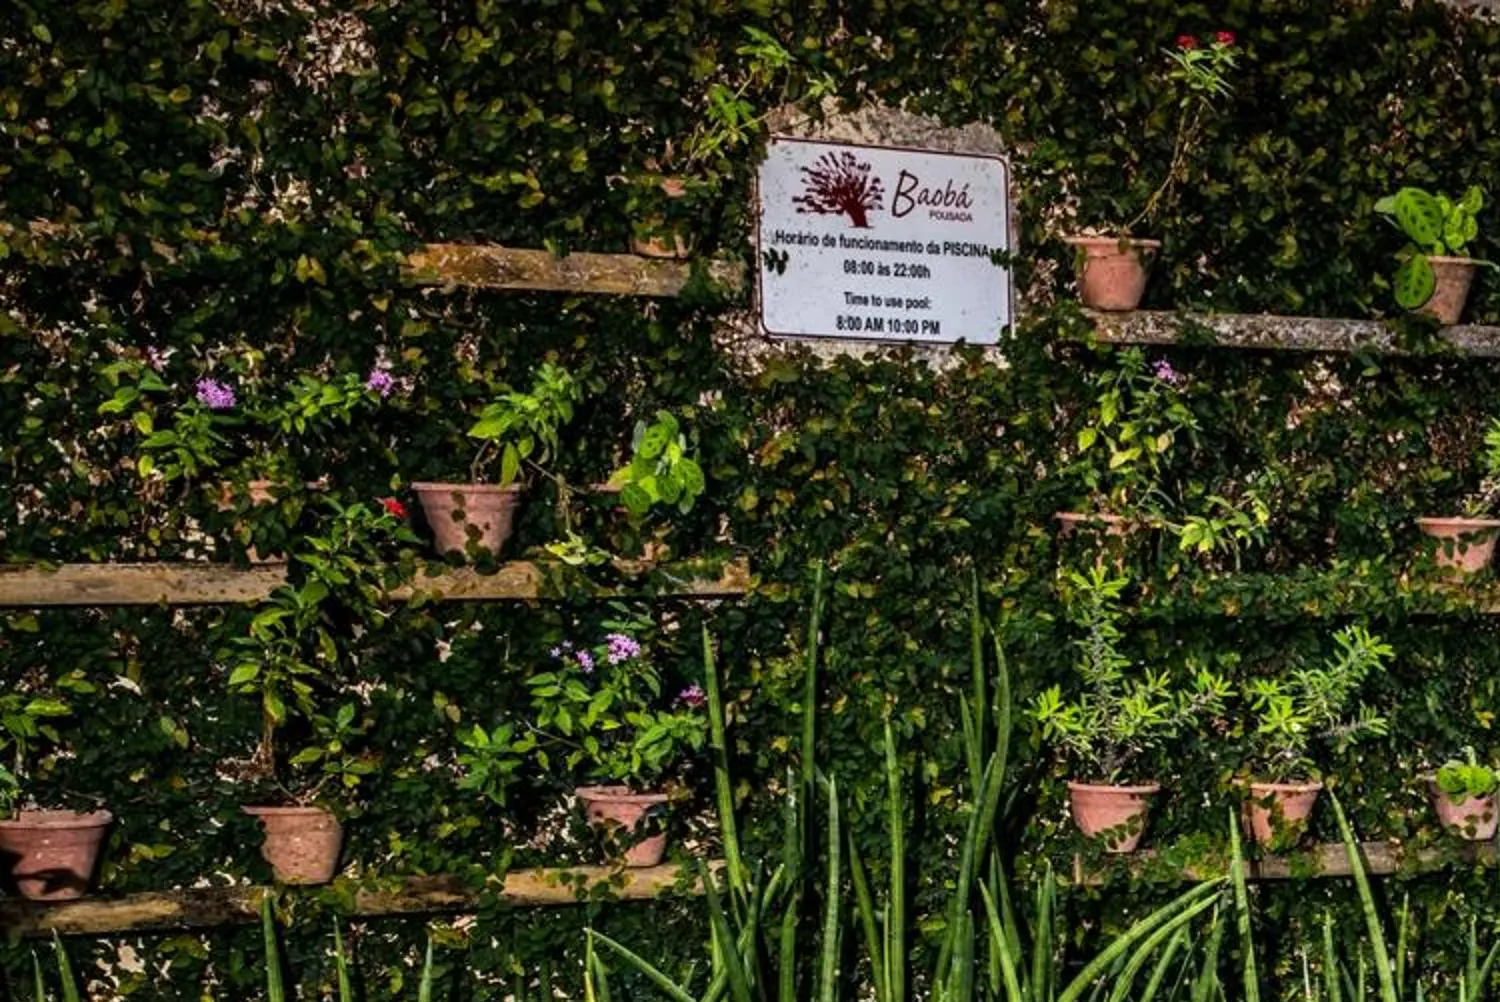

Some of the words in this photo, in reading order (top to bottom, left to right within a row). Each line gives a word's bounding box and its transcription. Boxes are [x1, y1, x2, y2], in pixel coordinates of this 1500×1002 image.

[892, 169, 973, 218] Baobá
[929, 210, 973, 223] POUSADA
[775, 229, 819, 247] Horário
[821, 234, 836, 248] de
[839, 233, 924, 254] funcionamento
[926, 241, 940, 255] da
[843, 259, 875, 275] 08:00
[877, 262, 891, 276] às
[893, 262, 931, 279] 22:00h
[844, 291, 869, 306] Time
[871, 294, 882, 307] to
[884, 297, 903, 308] use
[836, 315, 862, 331] 8:00
[863, 317, 884, 332] AM
[887, 318, 919, 334] 10:00
[921, 320, 940, 335] PM
